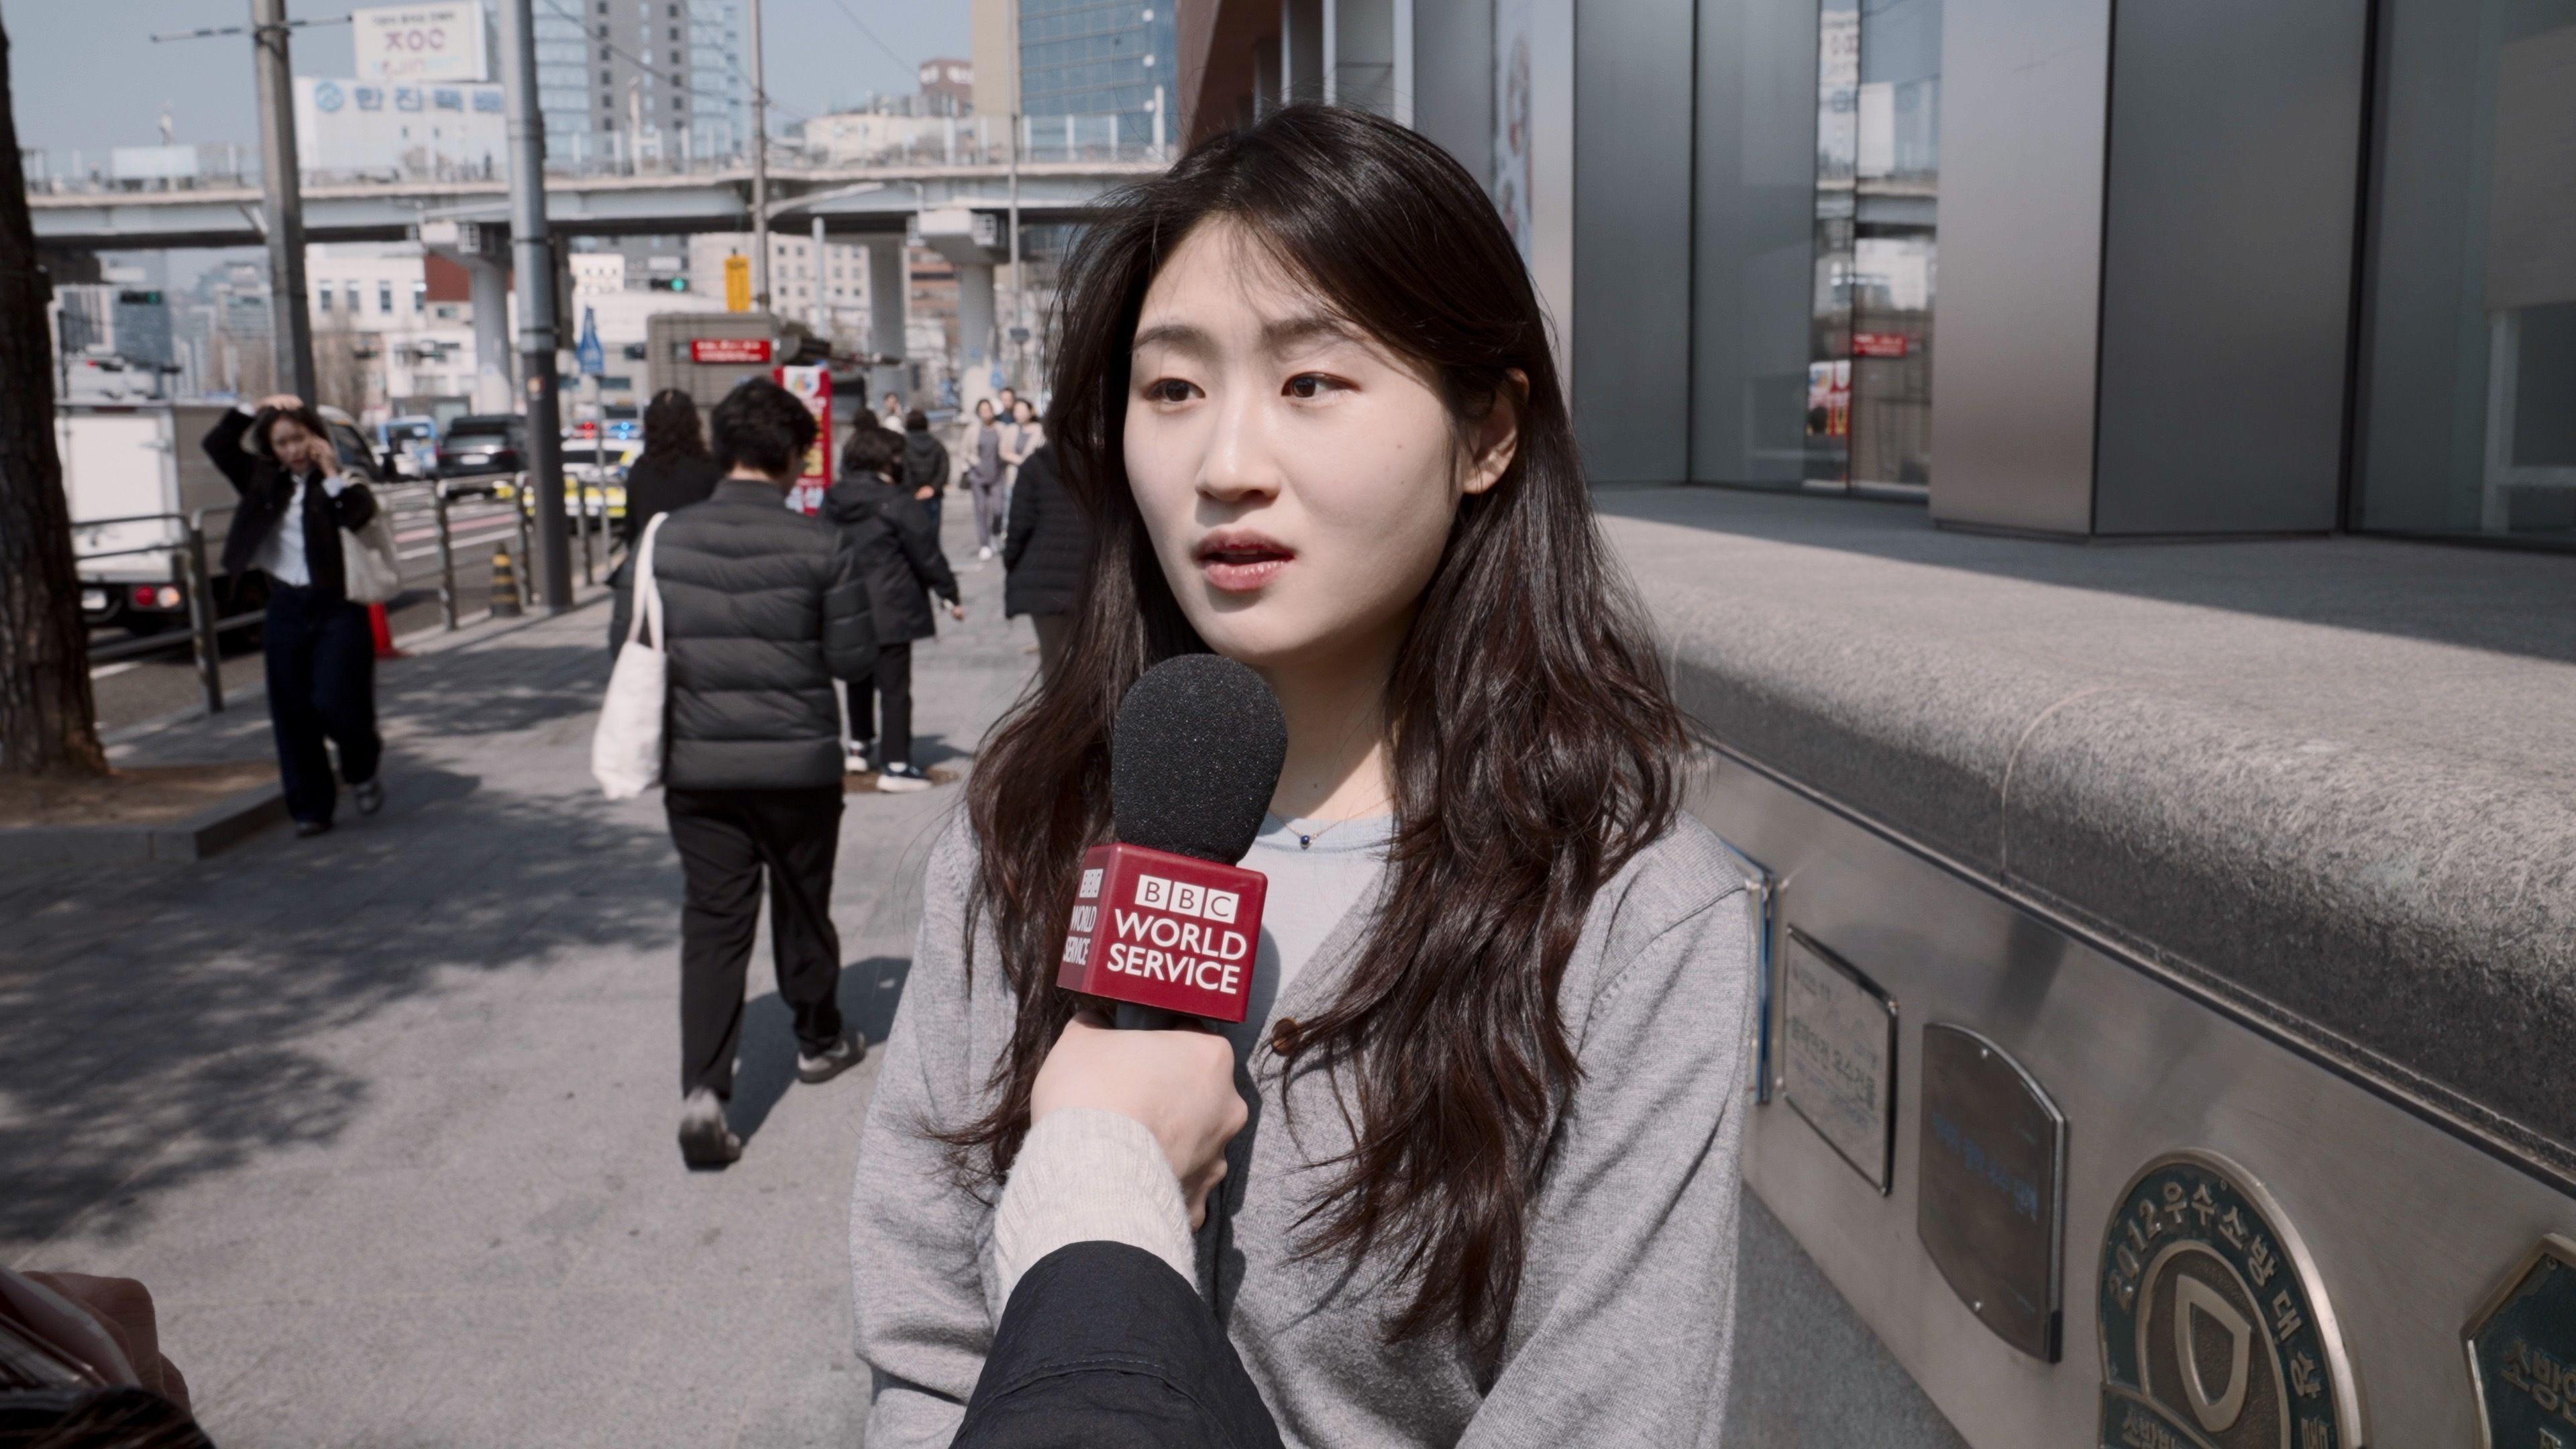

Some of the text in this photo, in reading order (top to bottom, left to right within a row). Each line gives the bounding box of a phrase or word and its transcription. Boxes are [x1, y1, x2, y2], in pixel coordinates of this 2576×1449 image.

[1071, 906, 1097, 933] WORLD
[1139, 877, 1236, 921] BBC
[1063, 936, 1091, 966] SERVICE
[1115, 908, 1247, 961] WORLD
[1107, 943, 1240, 994] SERVICE
